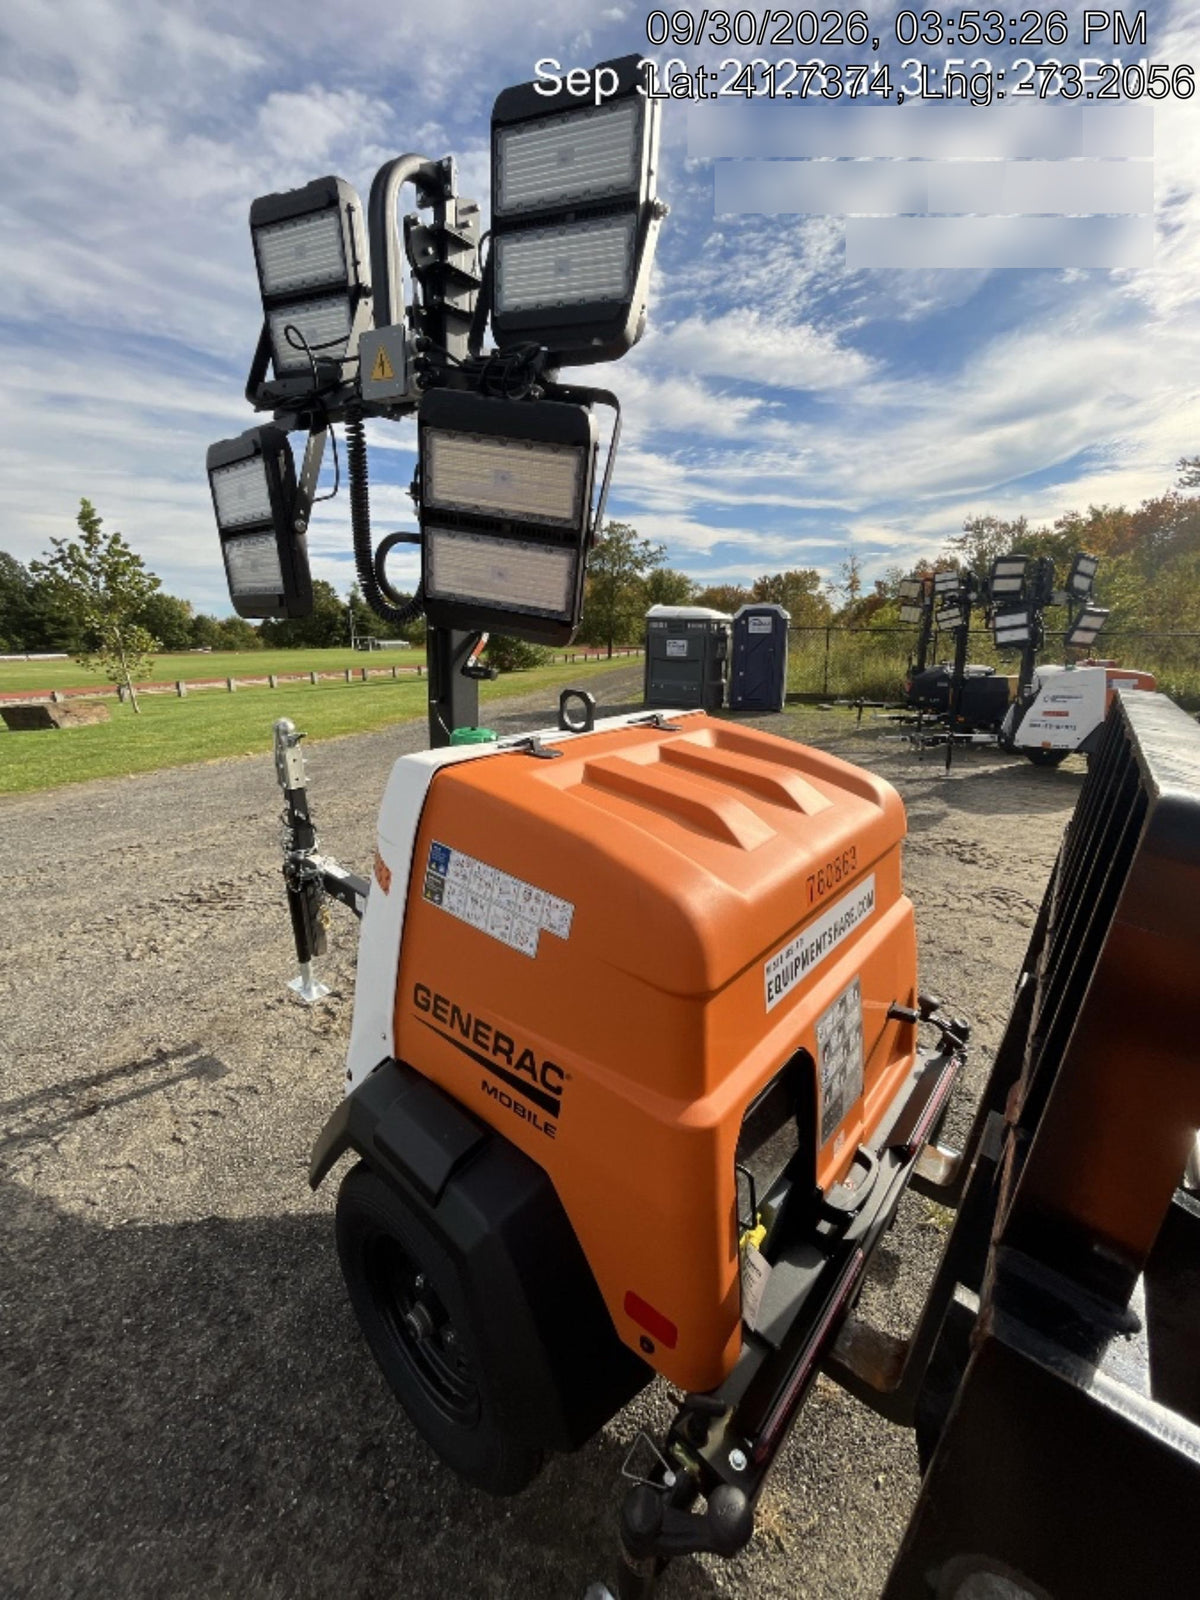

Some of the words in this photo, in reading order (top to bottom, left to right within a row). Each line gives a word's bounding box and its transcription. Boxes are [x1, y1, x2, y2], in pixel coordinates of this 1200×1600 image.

[806, 845, 858, 903] 760863
[413, 982, 565, 1096] GENERAC
[481, 1079, 558, 1140] MOBILE
